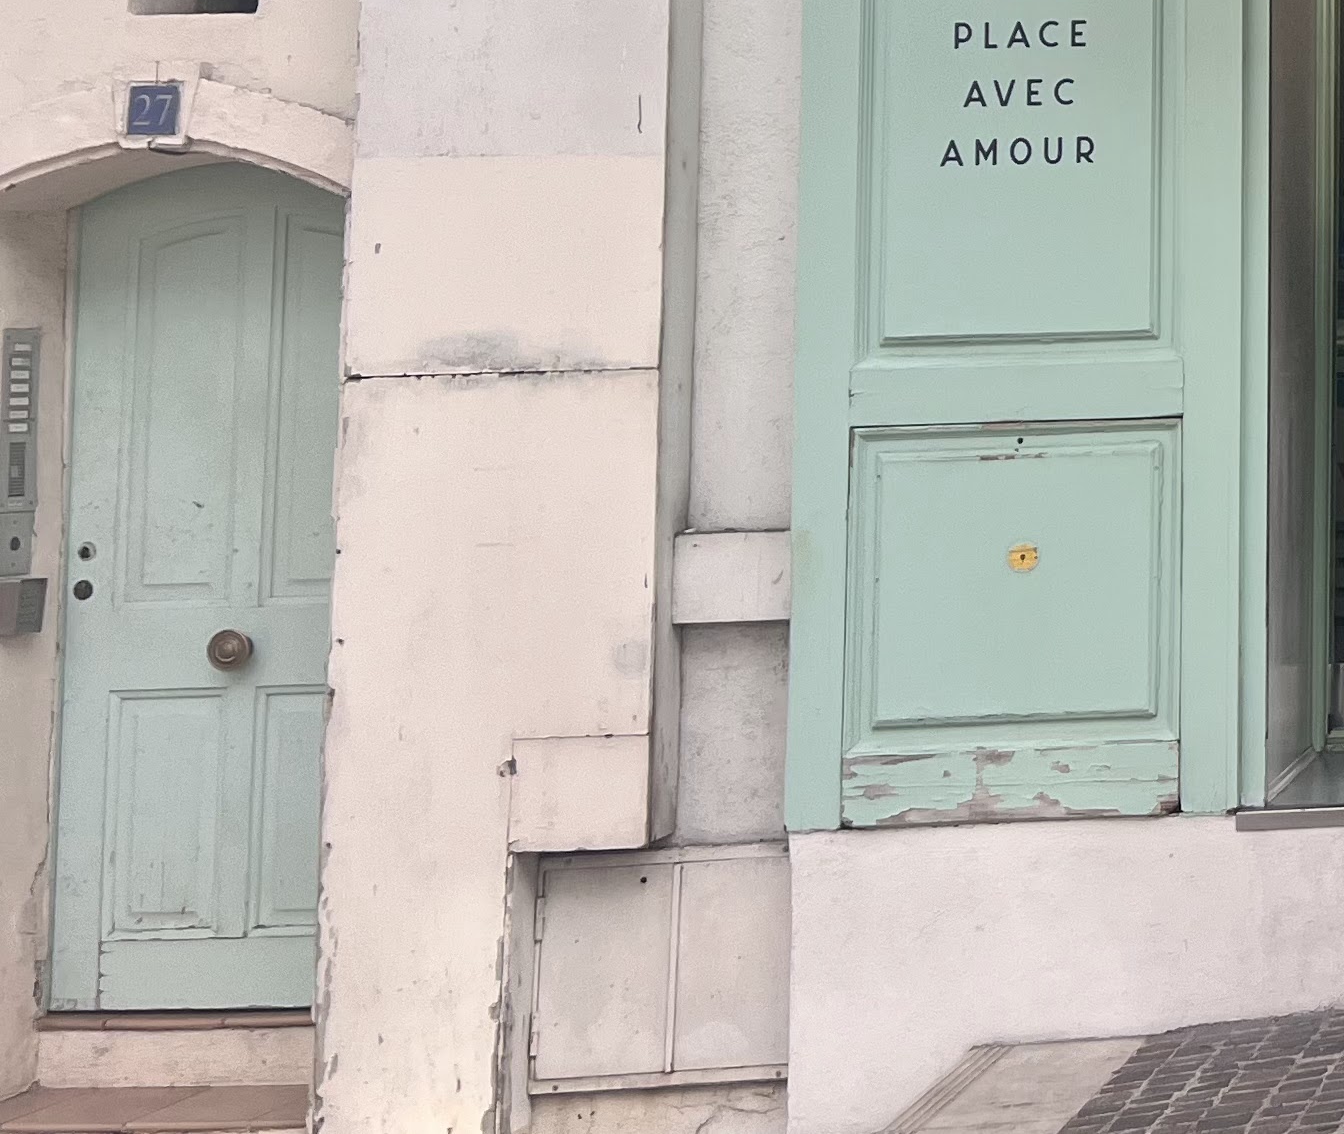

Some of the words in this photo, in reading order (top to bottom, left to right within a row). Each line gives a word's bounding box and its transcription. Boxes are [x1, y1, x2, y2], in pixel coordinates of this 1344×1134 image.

[954, 20, 1087, 48] PLACE
[963, 79, 1075, 107] AVEC
[131, 94, 174, 127] 27
[940, 136, 1095, 167] AMOUR
